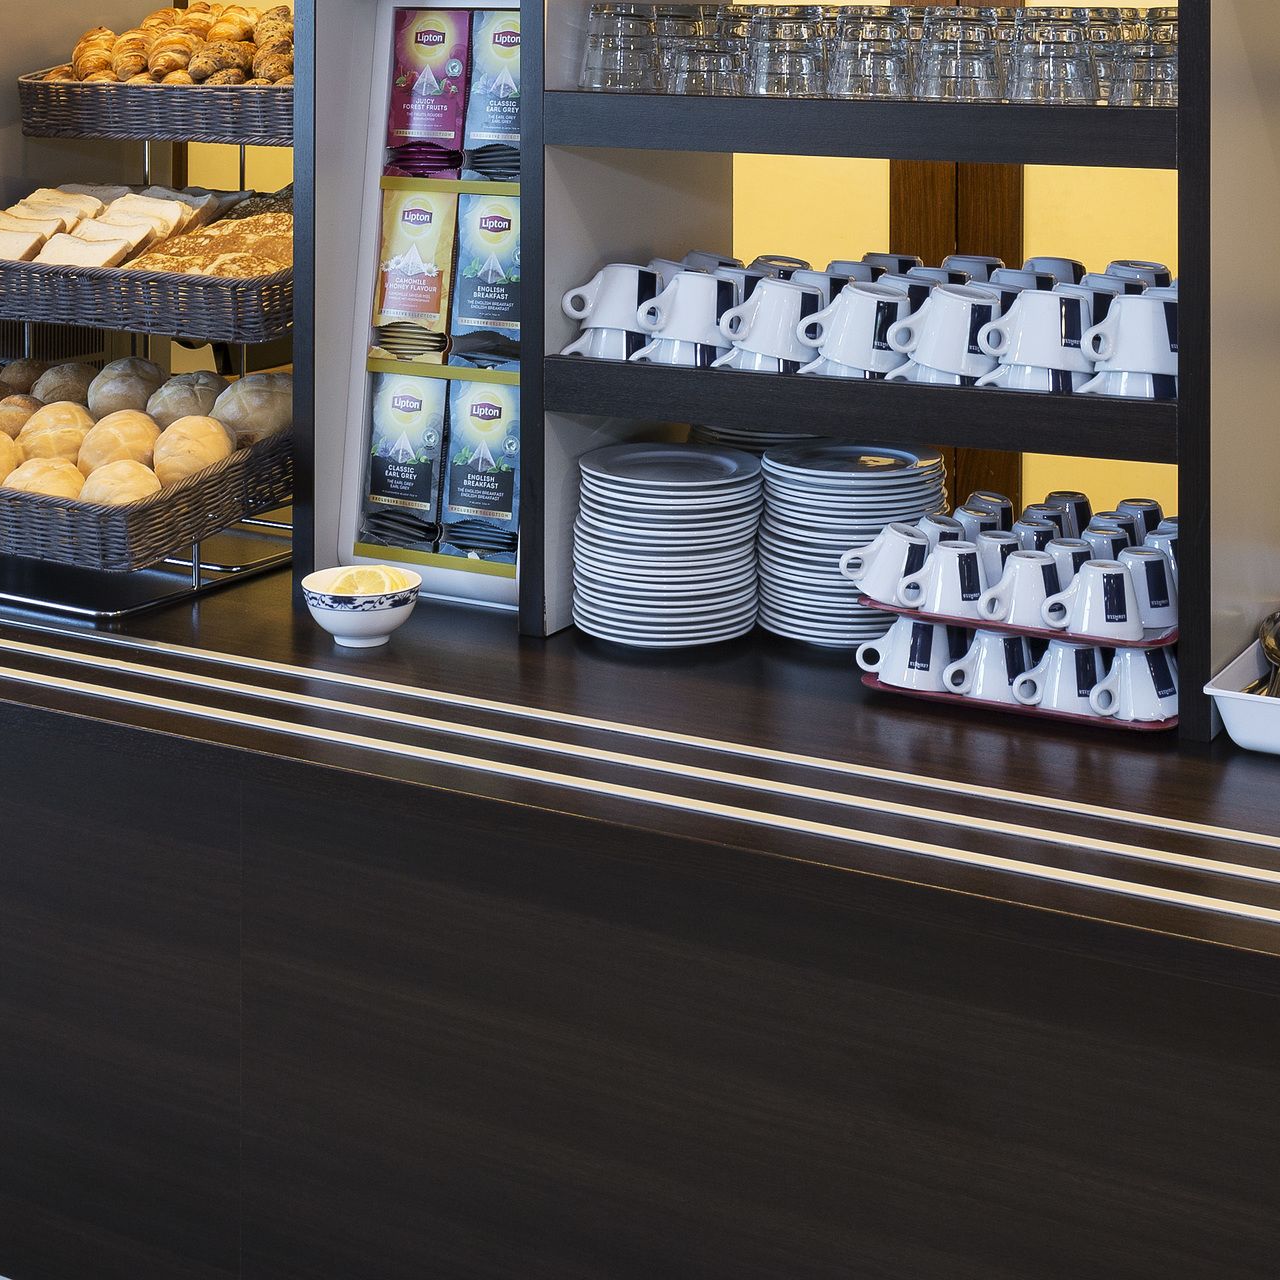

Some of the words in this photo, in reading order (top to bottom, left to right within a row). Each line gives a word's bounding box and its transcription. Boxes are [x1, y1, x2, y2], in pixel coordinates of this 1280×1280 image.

[417, 33, 443, 43] Lipton
[495, 35, 520, 44] Lipton
[404, 211, 430, 222] Lipton
[481, 219, 509, 229] Lipton
[395, 277, 427, 286] CAMOMILE
[410, 284, 437, 293] FLAVOUR
[473, 291, 509, 300] BREAKFAST
[394, 398, 420, 409] Lipton
[472, 405, 499, 417] Lipton
[388, 464, 415, 473] CLASSIC
[385, 470, 400, 478] EARL
[400, 472, 418, 480] GREY
[467, 473, 496, 482] ENGLISH
[463, 479, 499, 489] BREAKFAST
